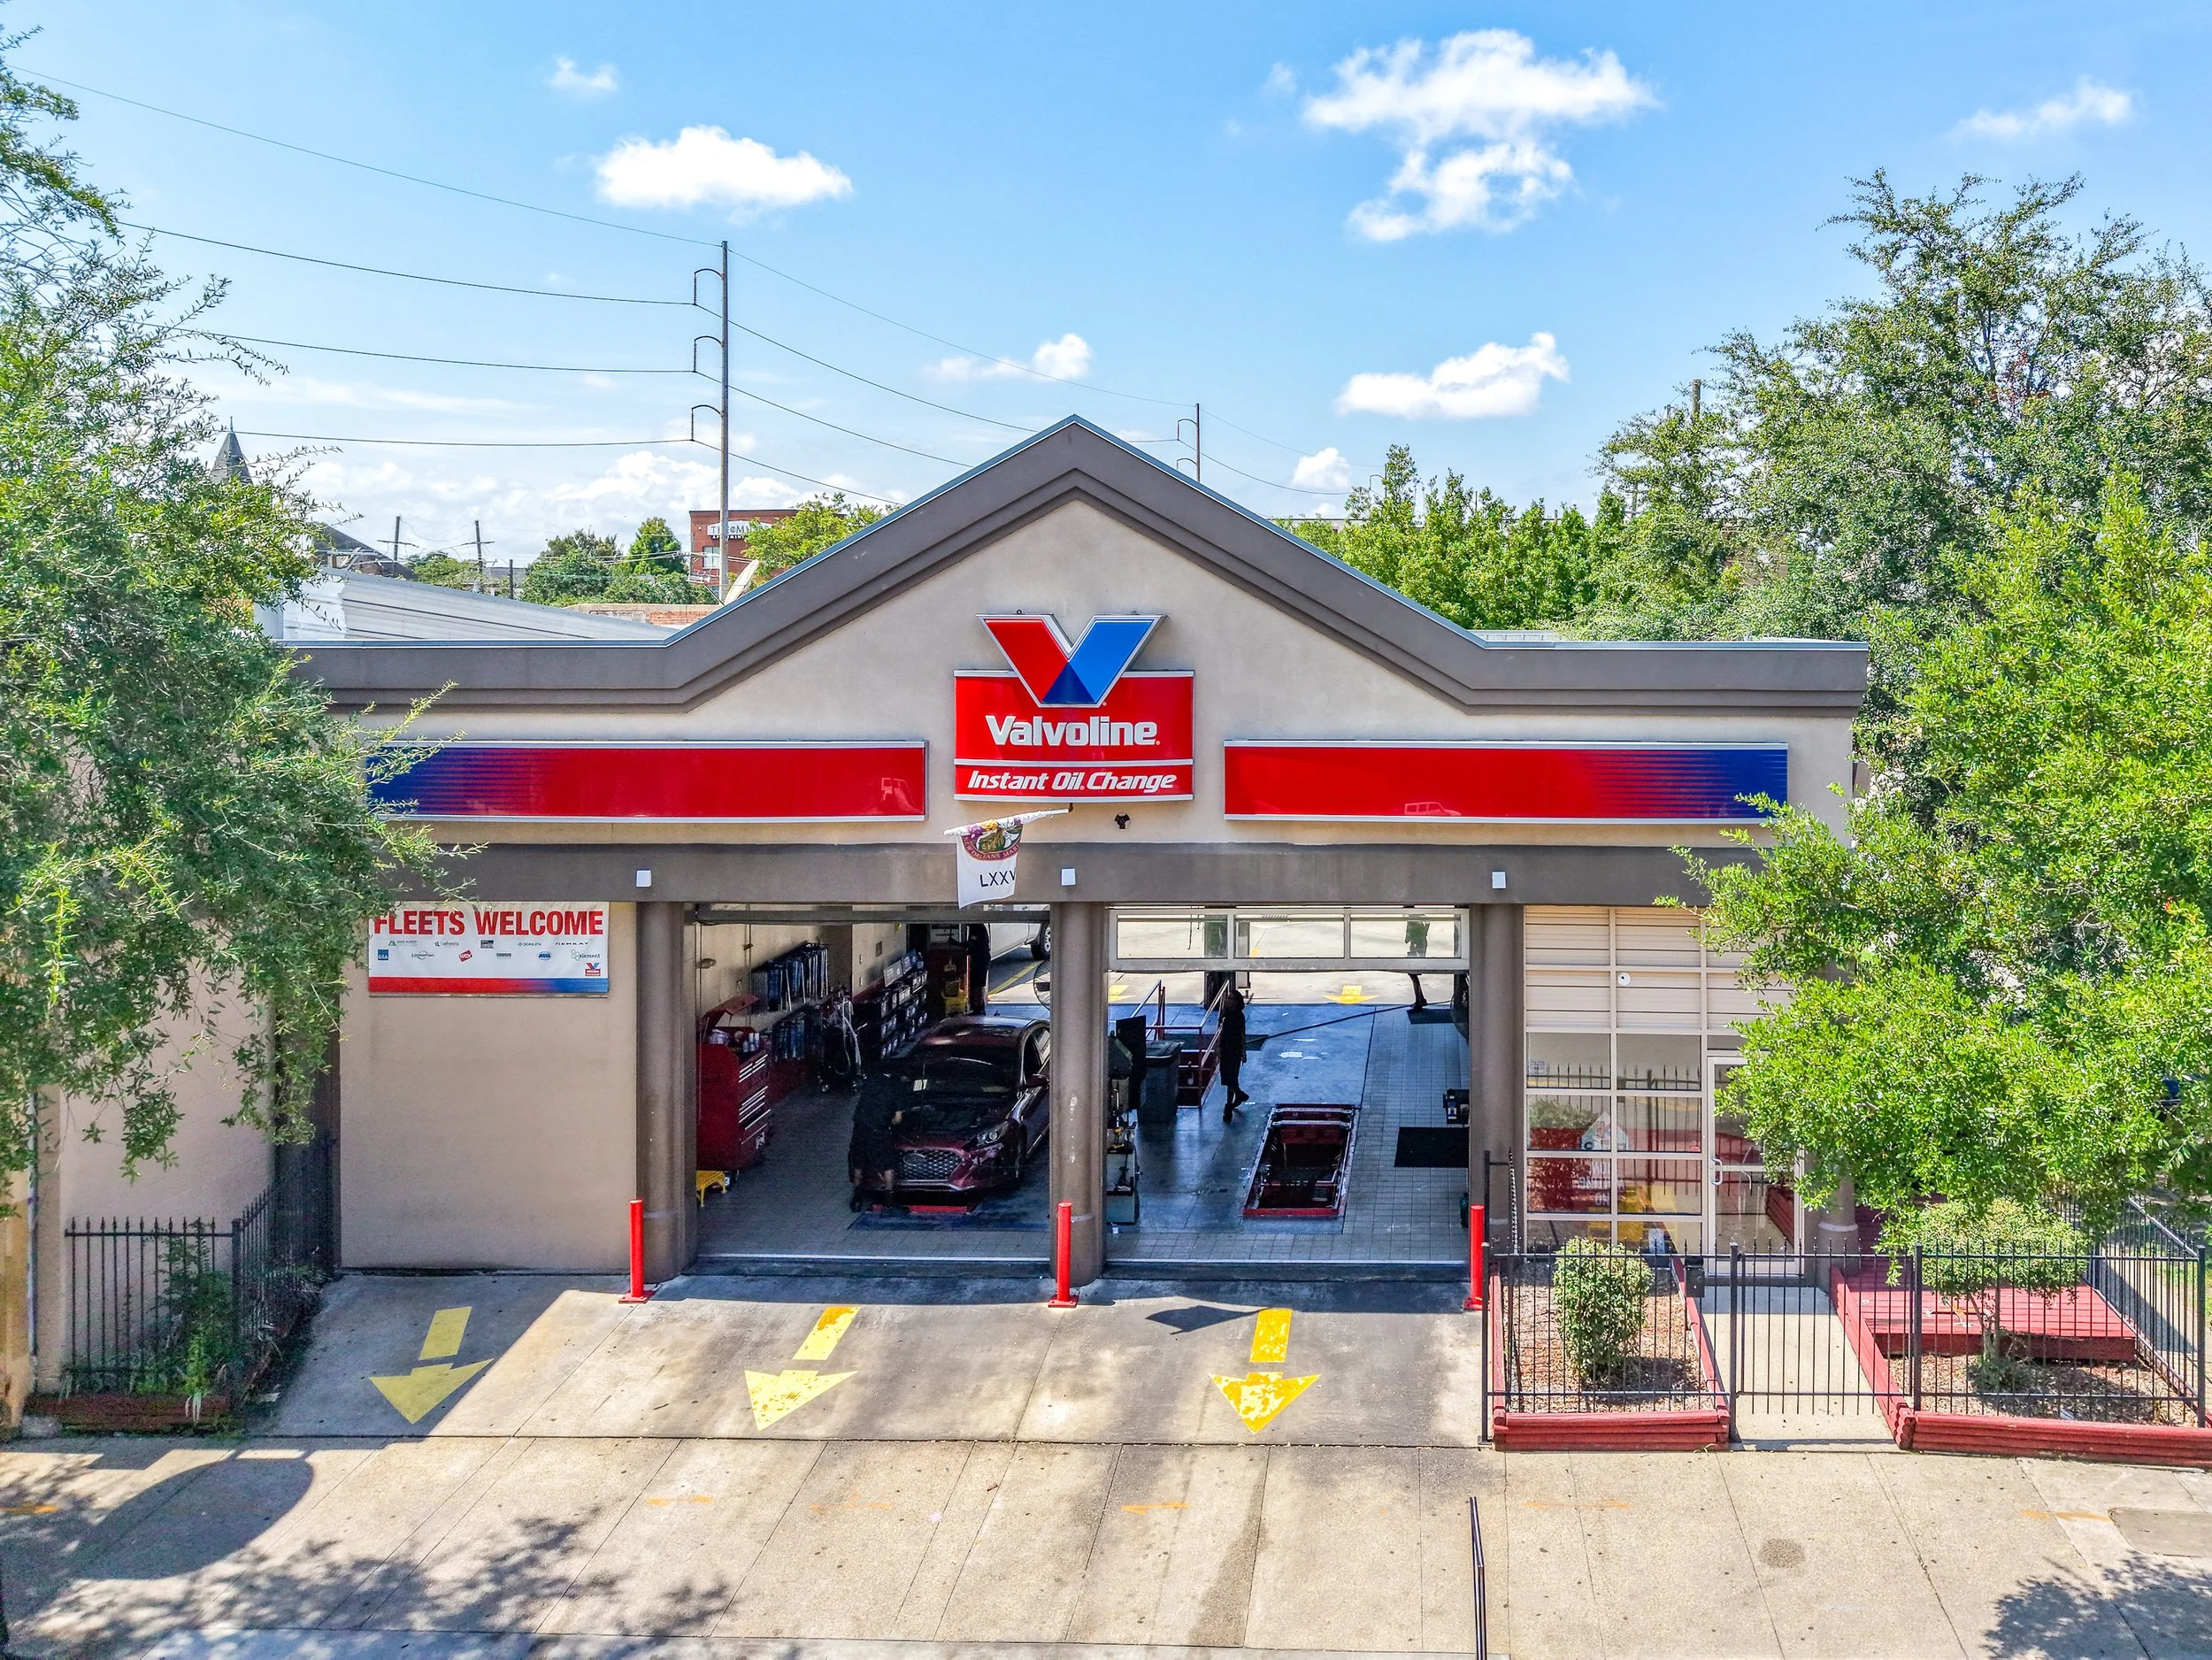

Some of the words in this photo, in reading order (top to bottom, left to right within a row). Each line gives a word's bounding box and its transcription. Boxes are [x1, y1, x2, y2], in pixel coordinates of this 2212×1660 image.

[985, 715, 1158, 747] Valvoline
[967, 770, 1049, 790] Instant
[1051, 772, 1086, 791] Oil
[1087, 772, 1178, 794] Change
[972, 850, 1001, 860] ORLEANS
[373, 910, 465, 935] FLEETS
[474, 911, 604, 936] WELCOME
